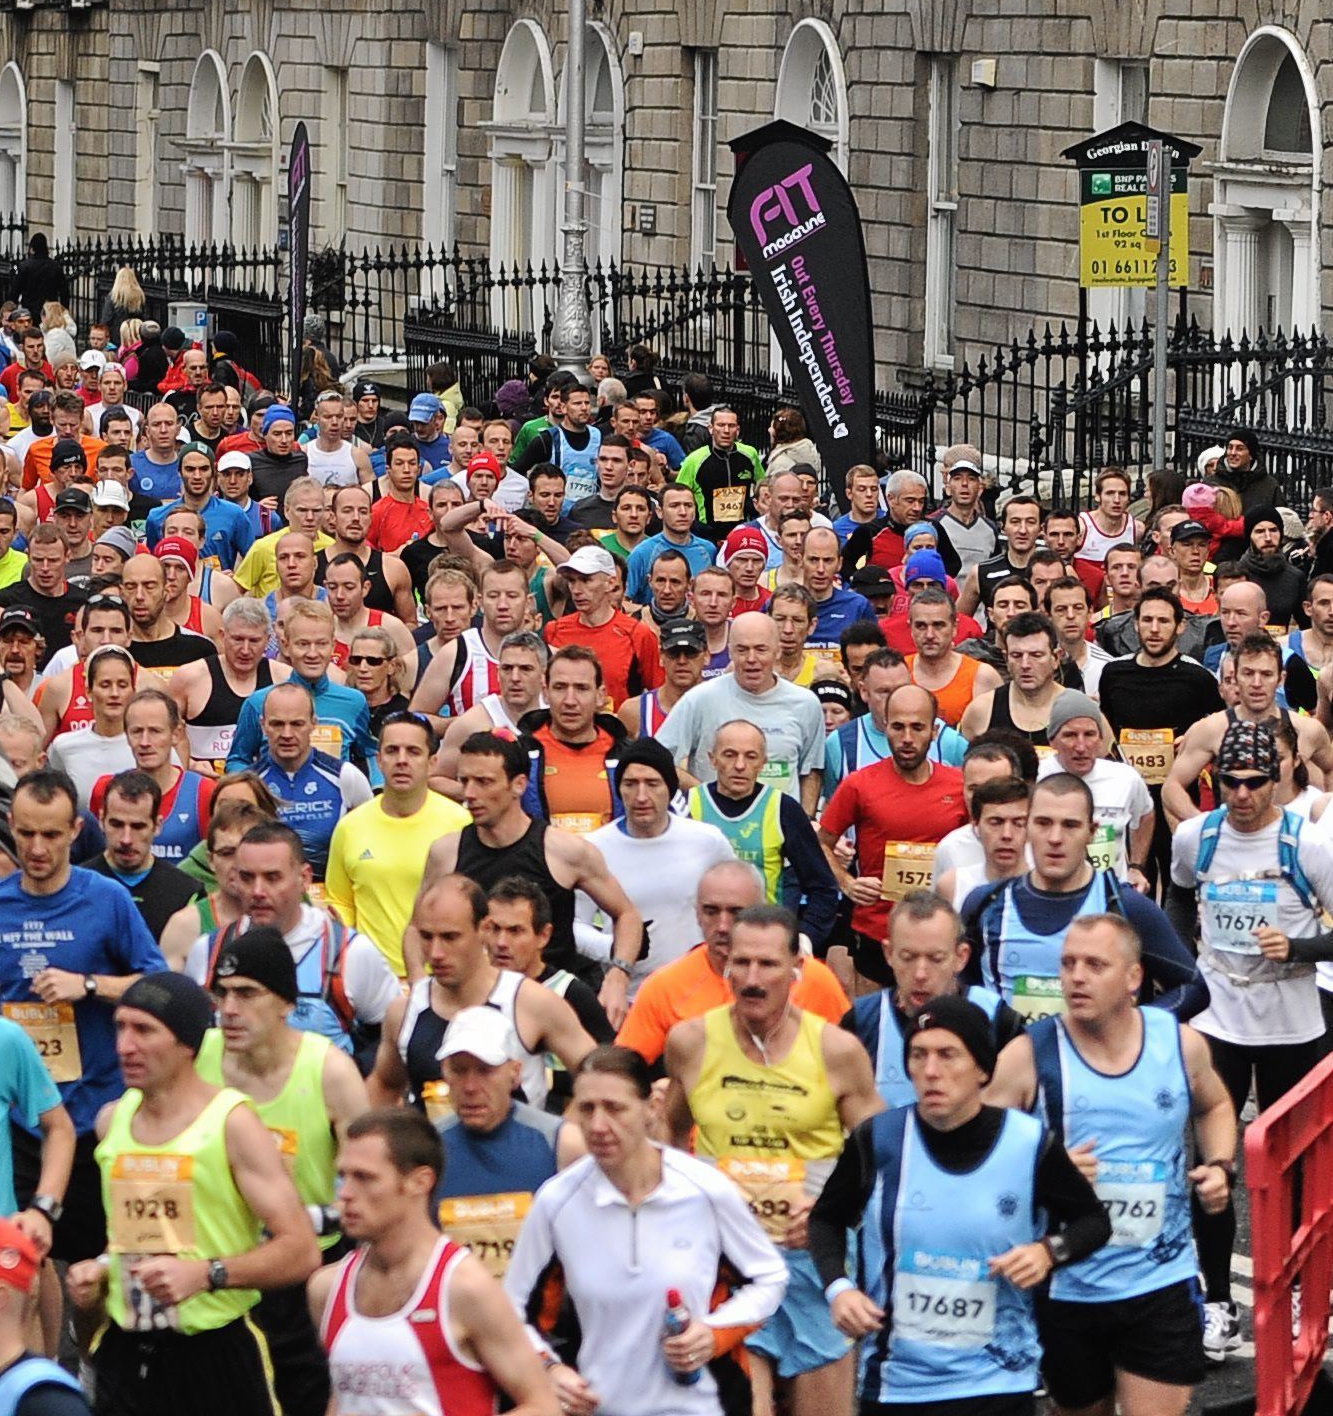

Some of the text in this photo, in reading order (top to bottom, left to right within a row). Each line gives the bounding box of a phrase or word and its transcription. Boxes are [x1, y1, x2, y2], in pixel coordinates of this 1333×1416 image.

[1086, 140, 1138, 160] Georgian
[1114, 175, 1135, 183] BNP
[1114, 184, 1138, 192] REAL
[749, 163, 821, 248] FIT
[1100, 207, 1129, 224] TO
[762, 211, 827, 260] magazine
[1096, 230, 1110, 239] 1st
[1112, 229, 1137, 238] Floor
[1114, 240, 1142, 250] 92 sq
[1092, 259, 1177, 274] 01 661123
[790, 255, 855, 406] Out Every Thursday
[770, 264, 841, 427] Irish Independent
[1128, 754, 1166, 768] 1483
[44, 930, 75, 942] WALL
[123, 1158, 179, 1175] DUBLIN
[123, 1198, 180, 1221] 1928
[907, 1290, 984, 1319] 17687
